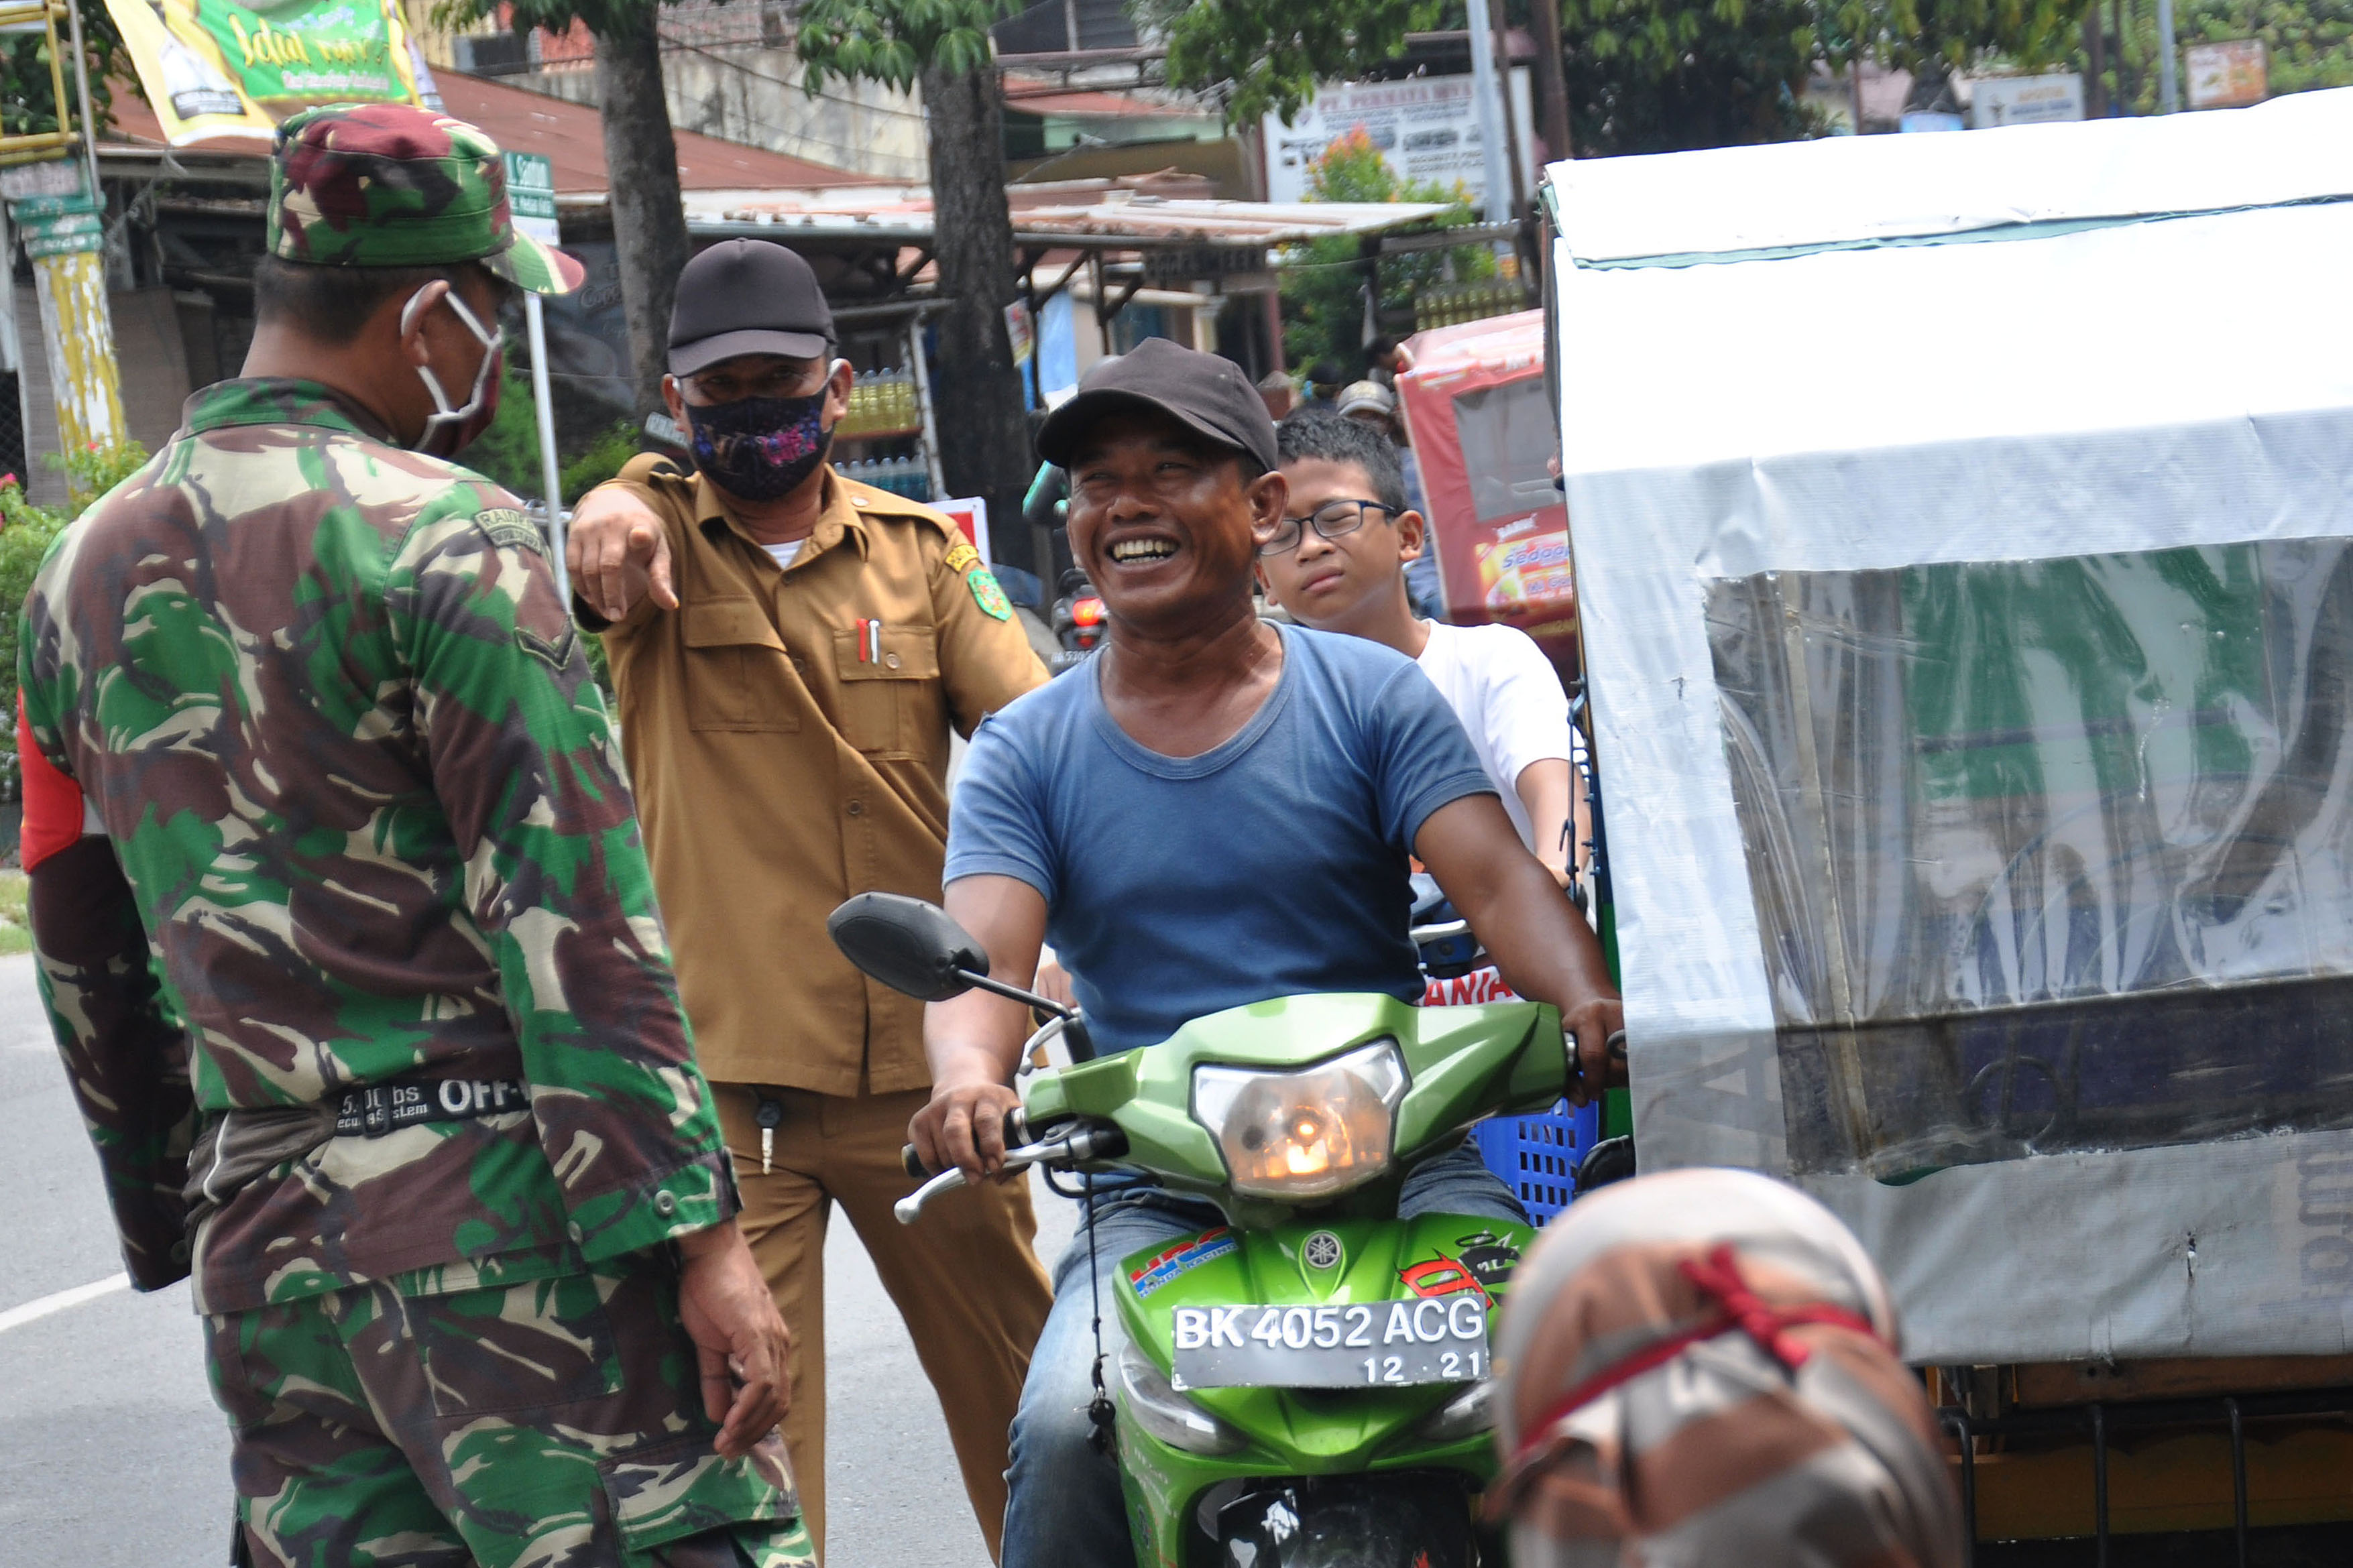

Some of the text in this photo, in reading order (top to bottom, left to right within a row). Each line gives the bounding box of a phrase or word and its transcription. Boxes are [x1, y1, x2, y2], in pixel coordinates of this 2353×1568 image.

[1415, 972, 1513, 1006] ANIA
[1139, 1242, 1239, 1299] HONDA RACING
[1175, 1297, 1484, 1349] BK 4052 ACG
[1364, 1351, 1481, 1383] 12 21
